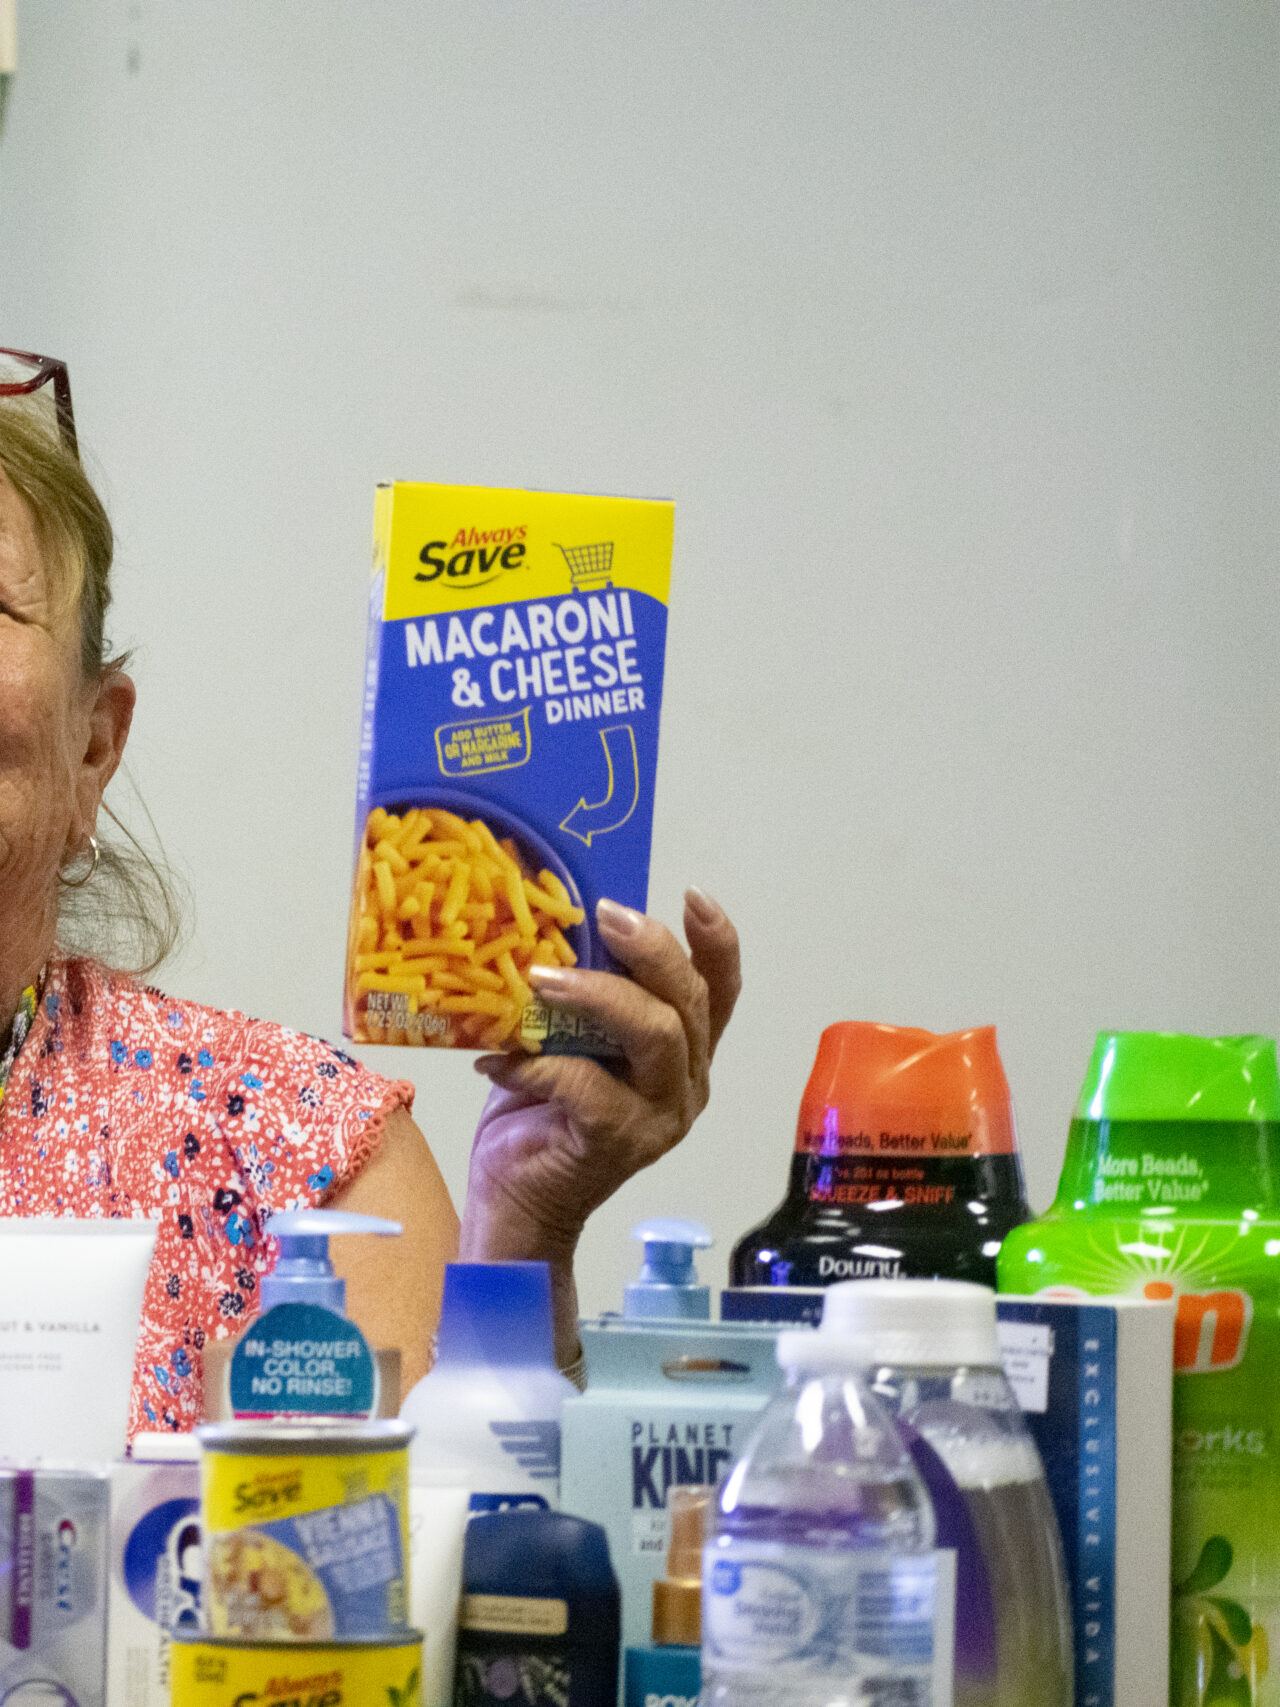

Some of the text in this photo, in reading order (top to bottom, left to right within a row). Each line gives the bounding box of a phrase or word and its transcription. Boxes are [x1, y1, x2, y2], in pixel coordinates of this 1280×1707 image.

[450, 524, 528, 550] Always
[413, 541, 527, 583] Save
[404, 590, 635, 668] MACARONI
[451, 639, 643, 708] & CHEESE
[545, 686, 646, 725] DINNER
[473, 722, 512, 738] BUTTER
[367, 992, 390, 1011] NET
[879, 1132, 926, 1151] Better
[1098, 1153, 1203, 1179] More Beads,
[904, 1186, 956, 1204] SNIFF
[1094, 1179, 1144, 1203] Better
[819, 1256, 900, 1281] Downy
[38, 1322, 101, 1333] VANILLA
[245, 1340, 361, 1358] IN-SHOWER
[251, 1377, 353, 1396] NO RINSE!
[631, 1421, 734, 1446] PLANET
[1083, 1337, 1101, 1546] EXCLUSIVE
[1084, 1574, 1101, 1665] VIDA
